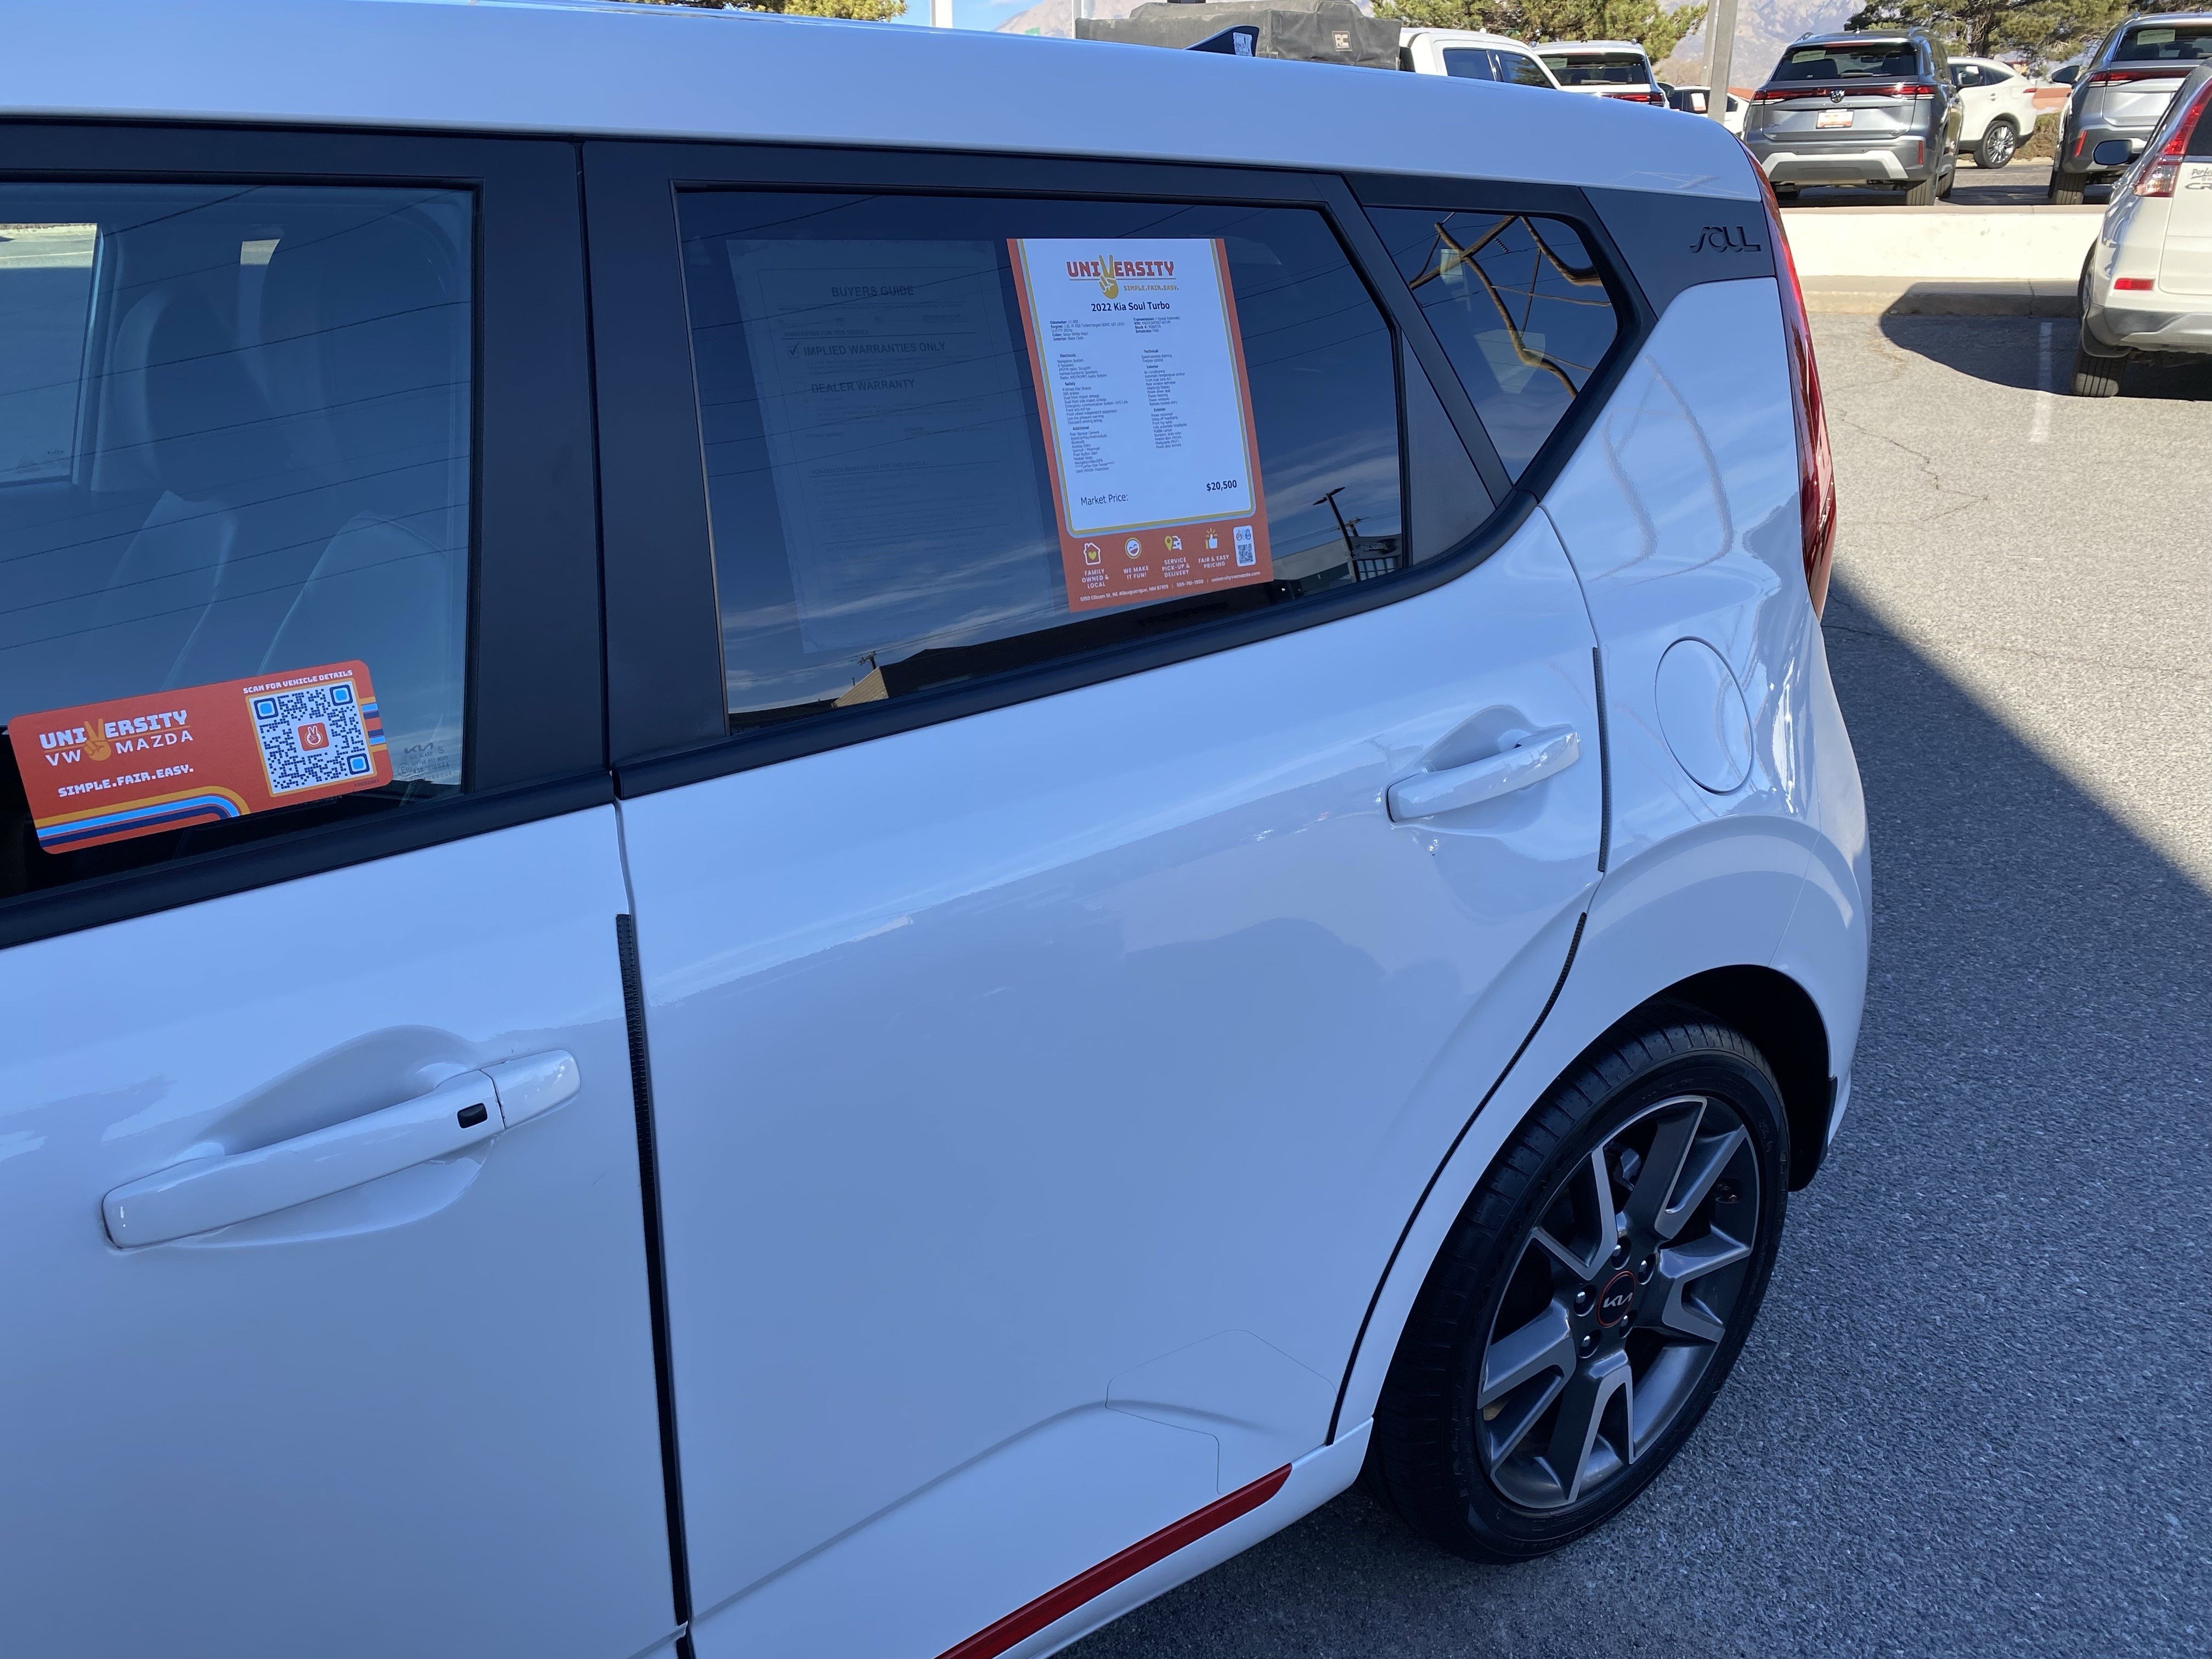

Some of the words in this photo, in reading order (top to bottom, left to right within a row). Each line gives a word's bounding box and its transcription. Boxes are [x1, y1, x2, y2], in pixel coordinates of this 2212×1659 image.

[1690, 226, 1762, 253] SOUL
[1066, 261, 1174, 277] UNIVERSITY
[831, 286, 878, 297] BUYERS
[881, 285, 915, 296] GUIDE
[1091, 303, 1111, 312] 2022
[1114, 302, 1126, 311] Kia
[1128, 302, 1146, 311] Soul
[1147, 301, 1170, 310] Turbo
[803, 345, 847, 357] IMPLIED
[850, 342, 917, 355] WARRANTIES
[918, 341, 946, 352] ONLY
[811, 382, 855, 394] DEALER
[856, 379, 915, 391] WARRANTY
[1206, 479, 1238, 493] $20,500
[1081, 495, 1107, 506] Market
[1108, 493, 1129, 504] Price:
[1164, 557, 1187, 565] SERVICE
[1164, 569, 1189, 578] DELIVERY
[242, 685, 265, 694] SCAN
[266, 682, 281, 691] FOR
[283, 675, 318, 687] VEHICLE
[319, 670, 353, 681] DETAILS
[39, 709, 188, 749] UNIVERSITY
[45, 749, 81, 766] VW
[115, 730, 194, 755] MAZDA
